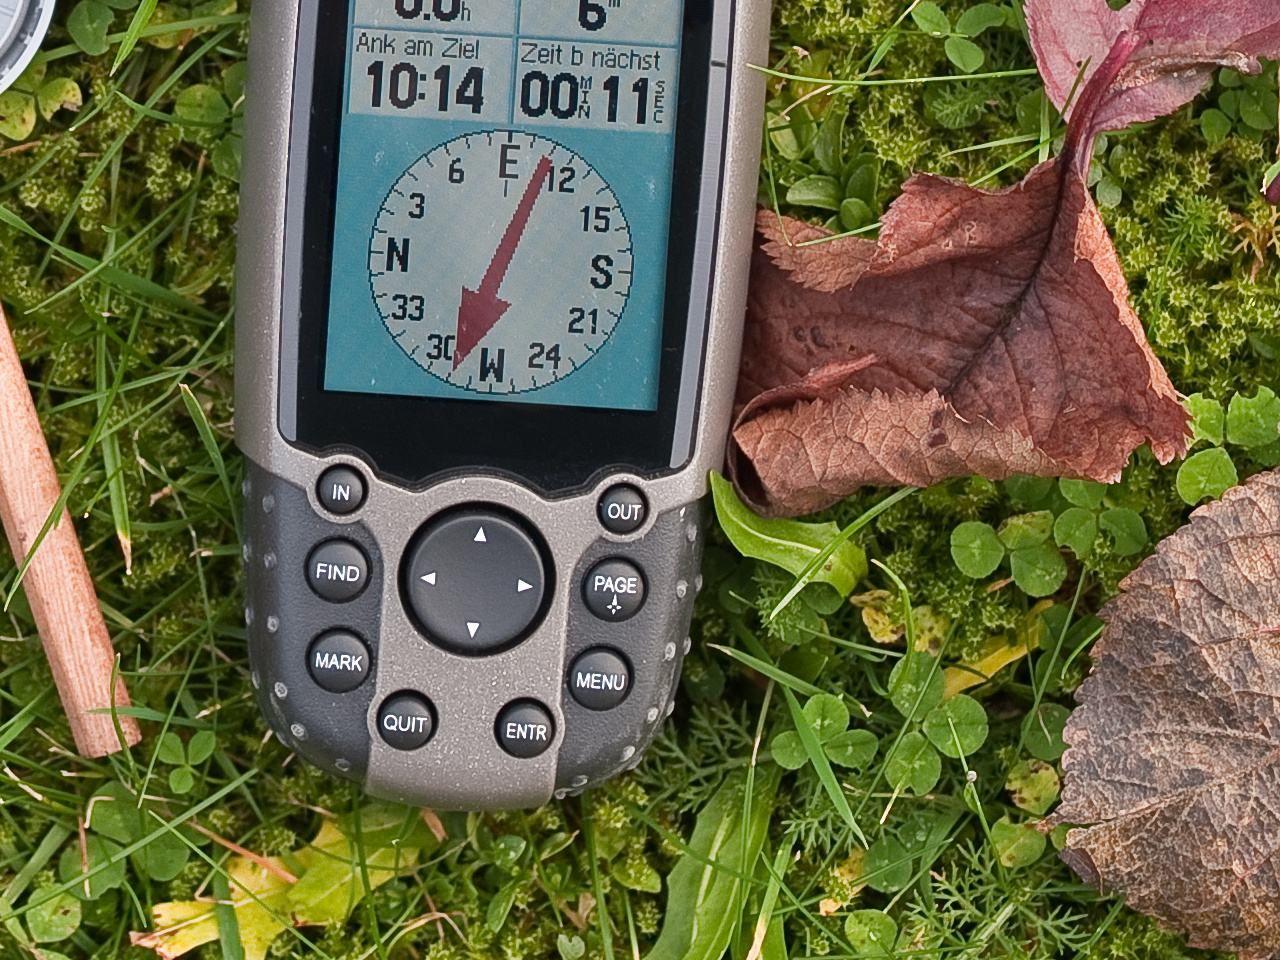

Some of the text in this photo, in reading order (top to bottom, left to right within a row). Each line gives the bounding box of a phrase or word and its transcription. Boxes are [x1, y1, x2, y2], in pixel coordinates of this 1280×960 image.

[356, 32, 480, 60] Ank am Ziel
[520, 42, 661, 71] Zeit b nächst
[367, 60, 484, 114] 10:14
[520, 70, 578, 120] 00
[603, 76, 649, 125] 11
[449, 158, 465, 184] 6
[499, 143, 520, 179] E
[548, 165, 576, 193] 12
[408, 192, 425, 219] 3
[580, 205, 611, 233] 15
[386, 237, 410, 272] N
[590, 254, 613, 289] S
[391, 294, 425, 321] 33
[568, 307, 598, 335] 21
[479, 347, 505, 383] W
[528, 342, 561, 370] 24
[332, 484, 351, 502] IN
[607, 502, 642, 522] OUT
[316, 563, 360, 583] FIND
[593, 576, 637, 594] PAGE
[315, 652, 363, 672] MARK
[576, 672, 625, 691] MENU
[383, 714, 428, 734] QUIT
[506, 722, 547, 741] ENTR
